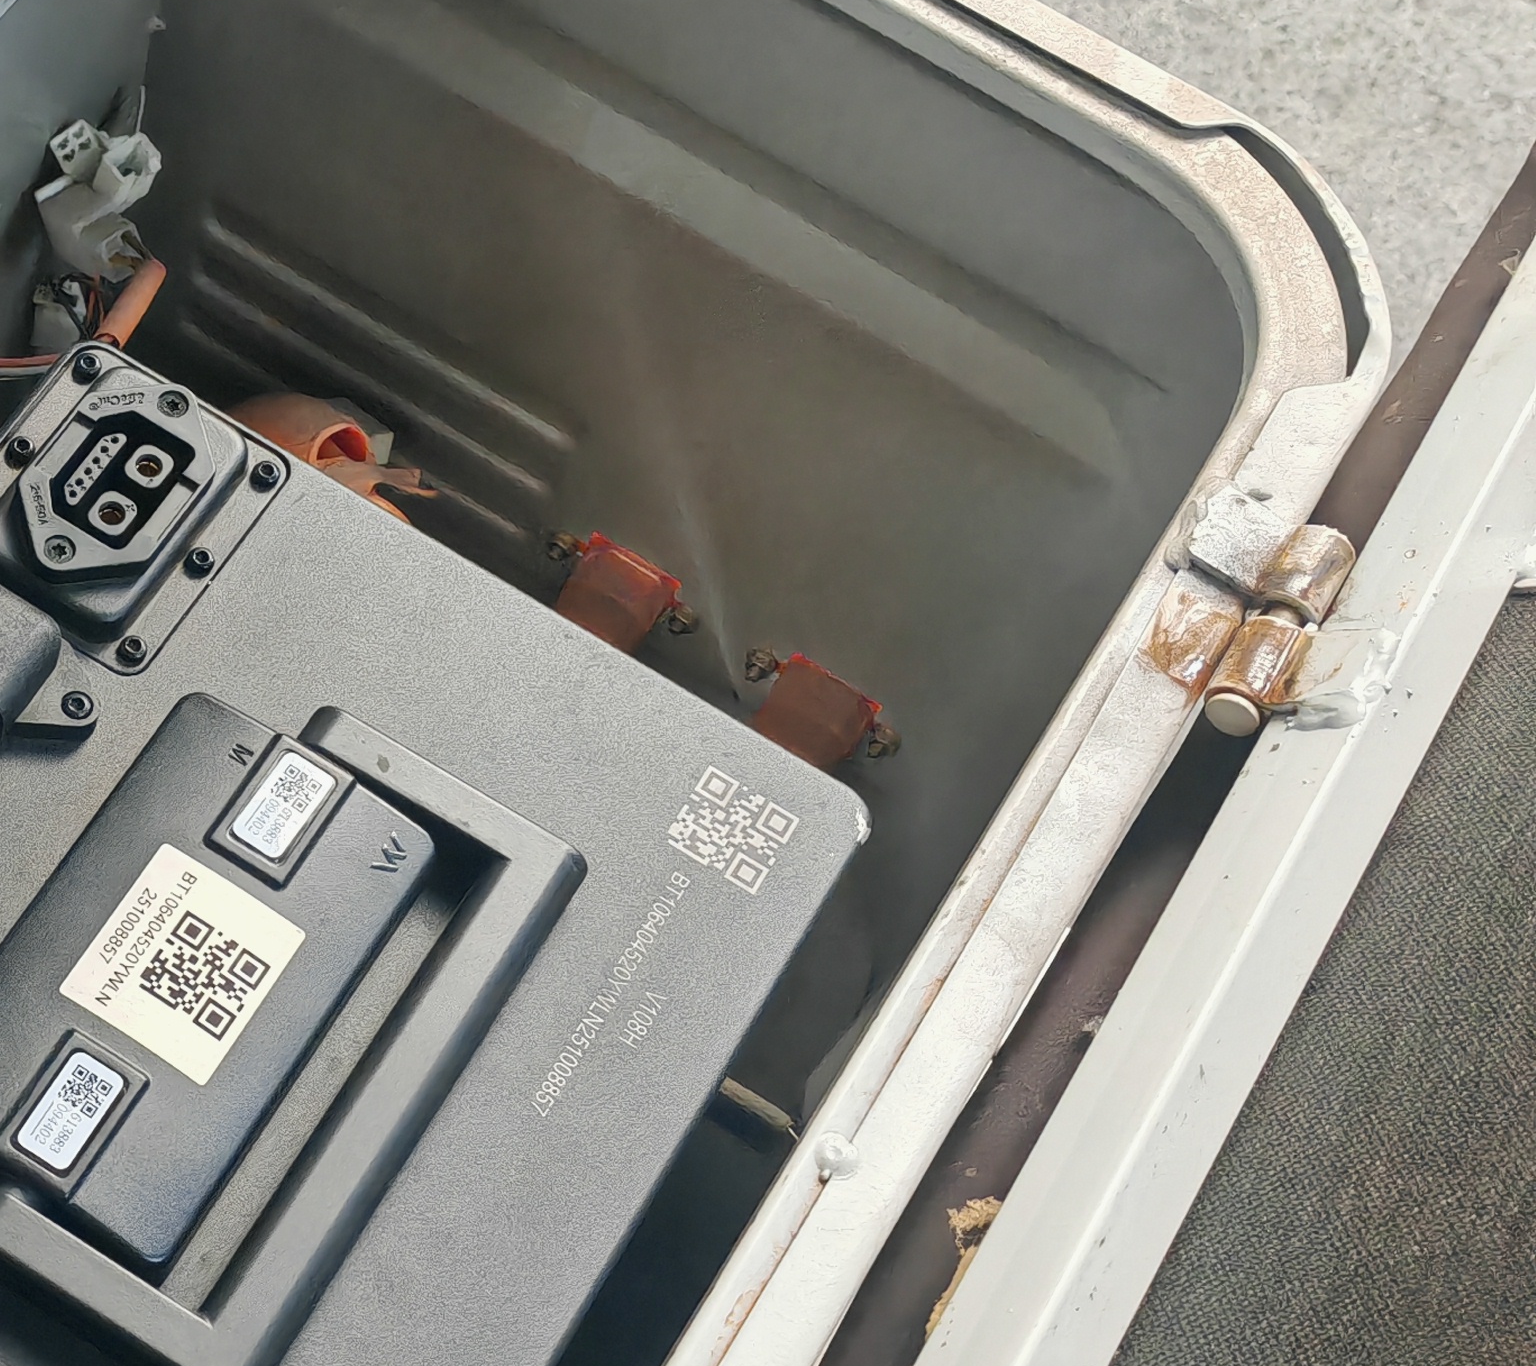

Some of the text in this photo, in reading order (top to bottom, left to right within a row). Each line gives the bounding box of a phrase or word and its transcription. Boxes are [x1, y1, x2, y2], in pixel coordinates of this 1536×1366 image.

[227, 742, 254, 767] M
[94, 871, 197, 1006] BT106404520YWLN
[98, 887, 159, 965] 251008857
[621, 990, 668, 1049] V108H
[35, 1101, 69, 1146] 094402
[49, 1111, 83, 1155] 613883
